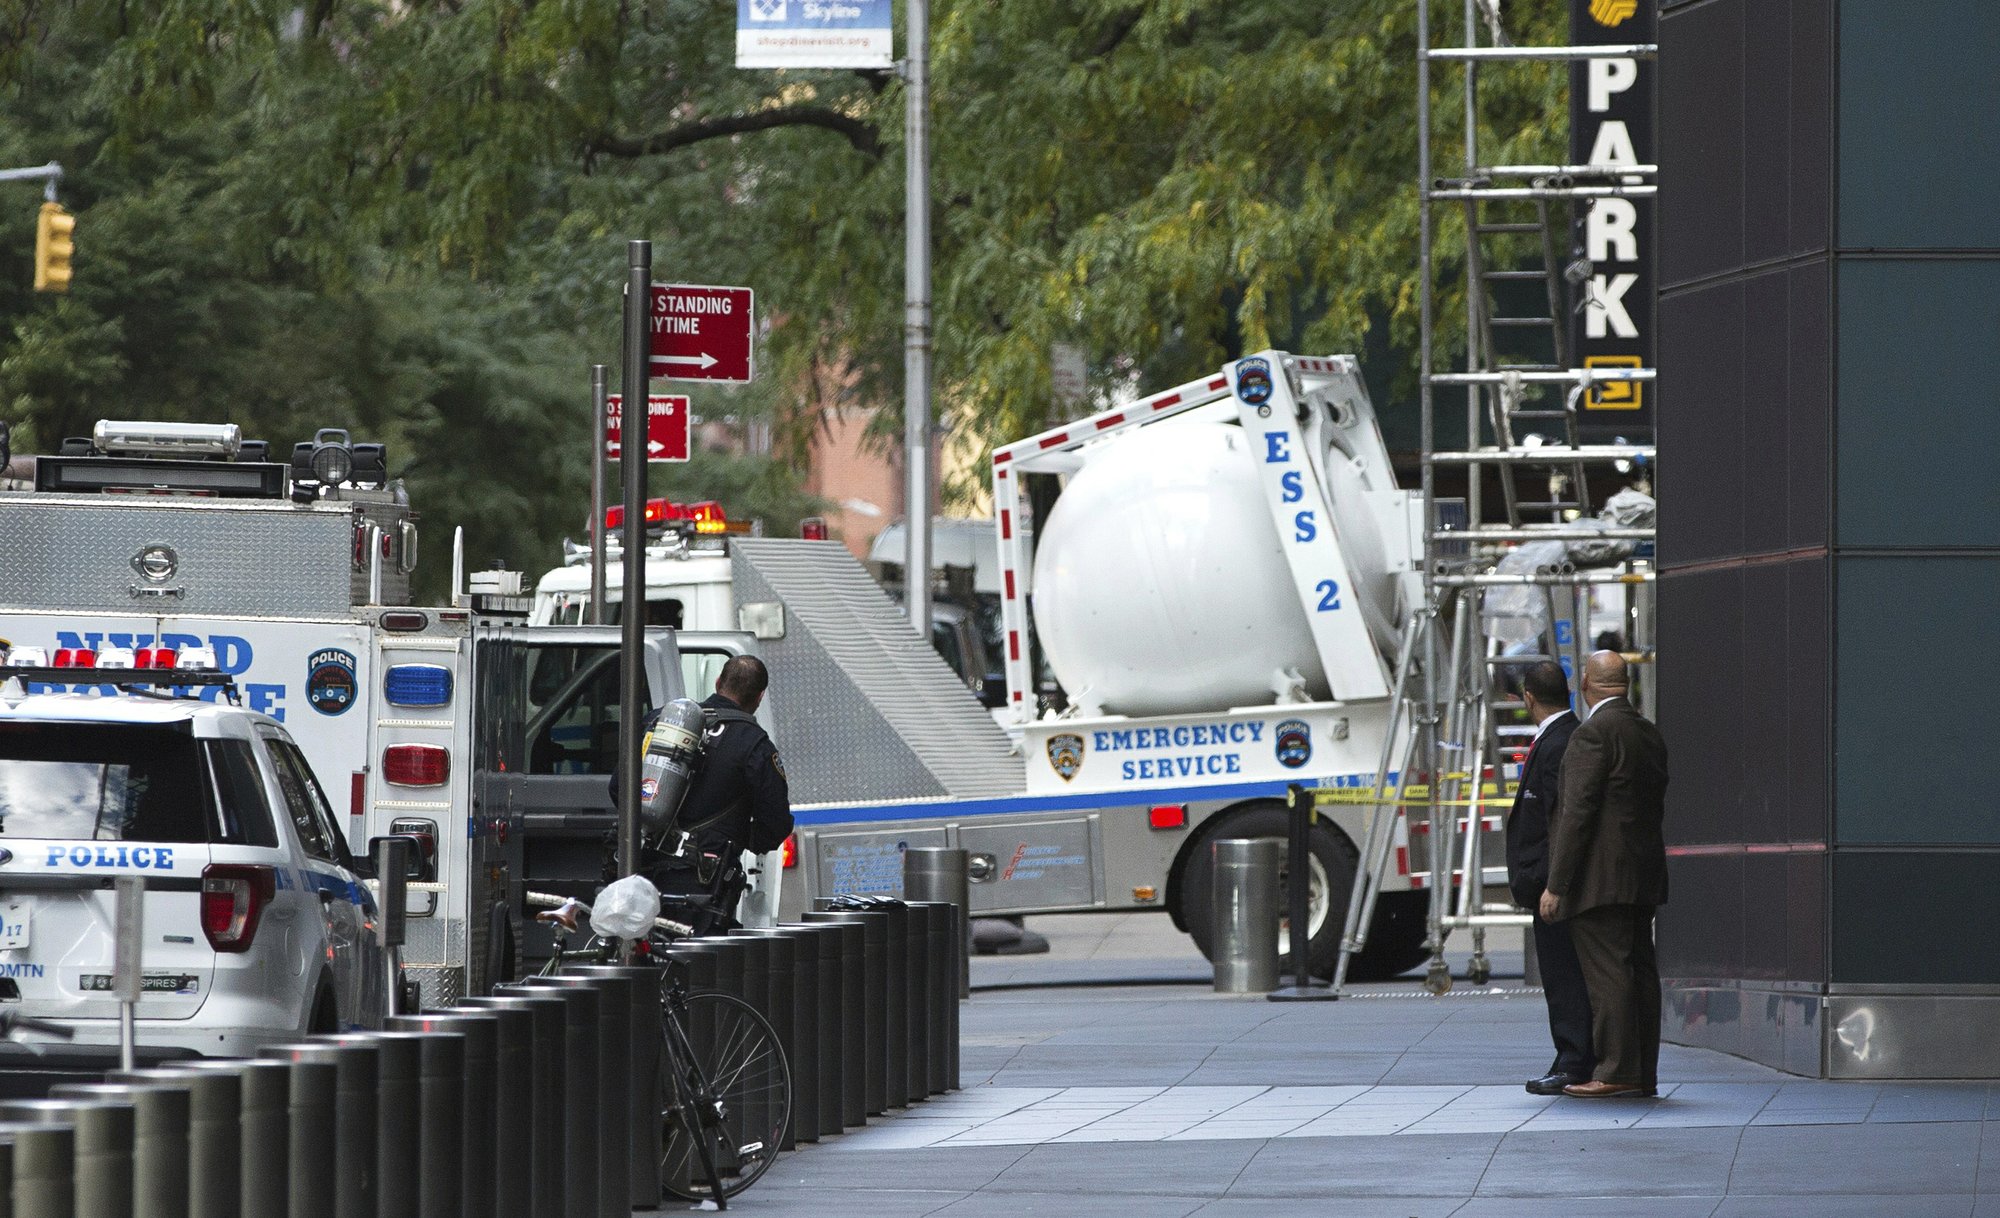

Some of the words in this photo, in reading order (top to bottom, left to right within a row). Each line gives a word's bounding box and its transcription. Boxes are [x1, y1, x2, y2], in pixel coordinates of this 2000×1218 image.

[1585, 57, 1643, 338] PARK
[657, 295, 732, 314] STANDING
[649, 317, 700, 334] YTIME
[311, 651, 354, 670] POLICE
[1094, 721, 1265, 752] EMERGENCY
[1121, 754, 1241, 780] SERVICE
[46, 846, 174, 869] POLICE
[6, 924, 23, 937] 17
